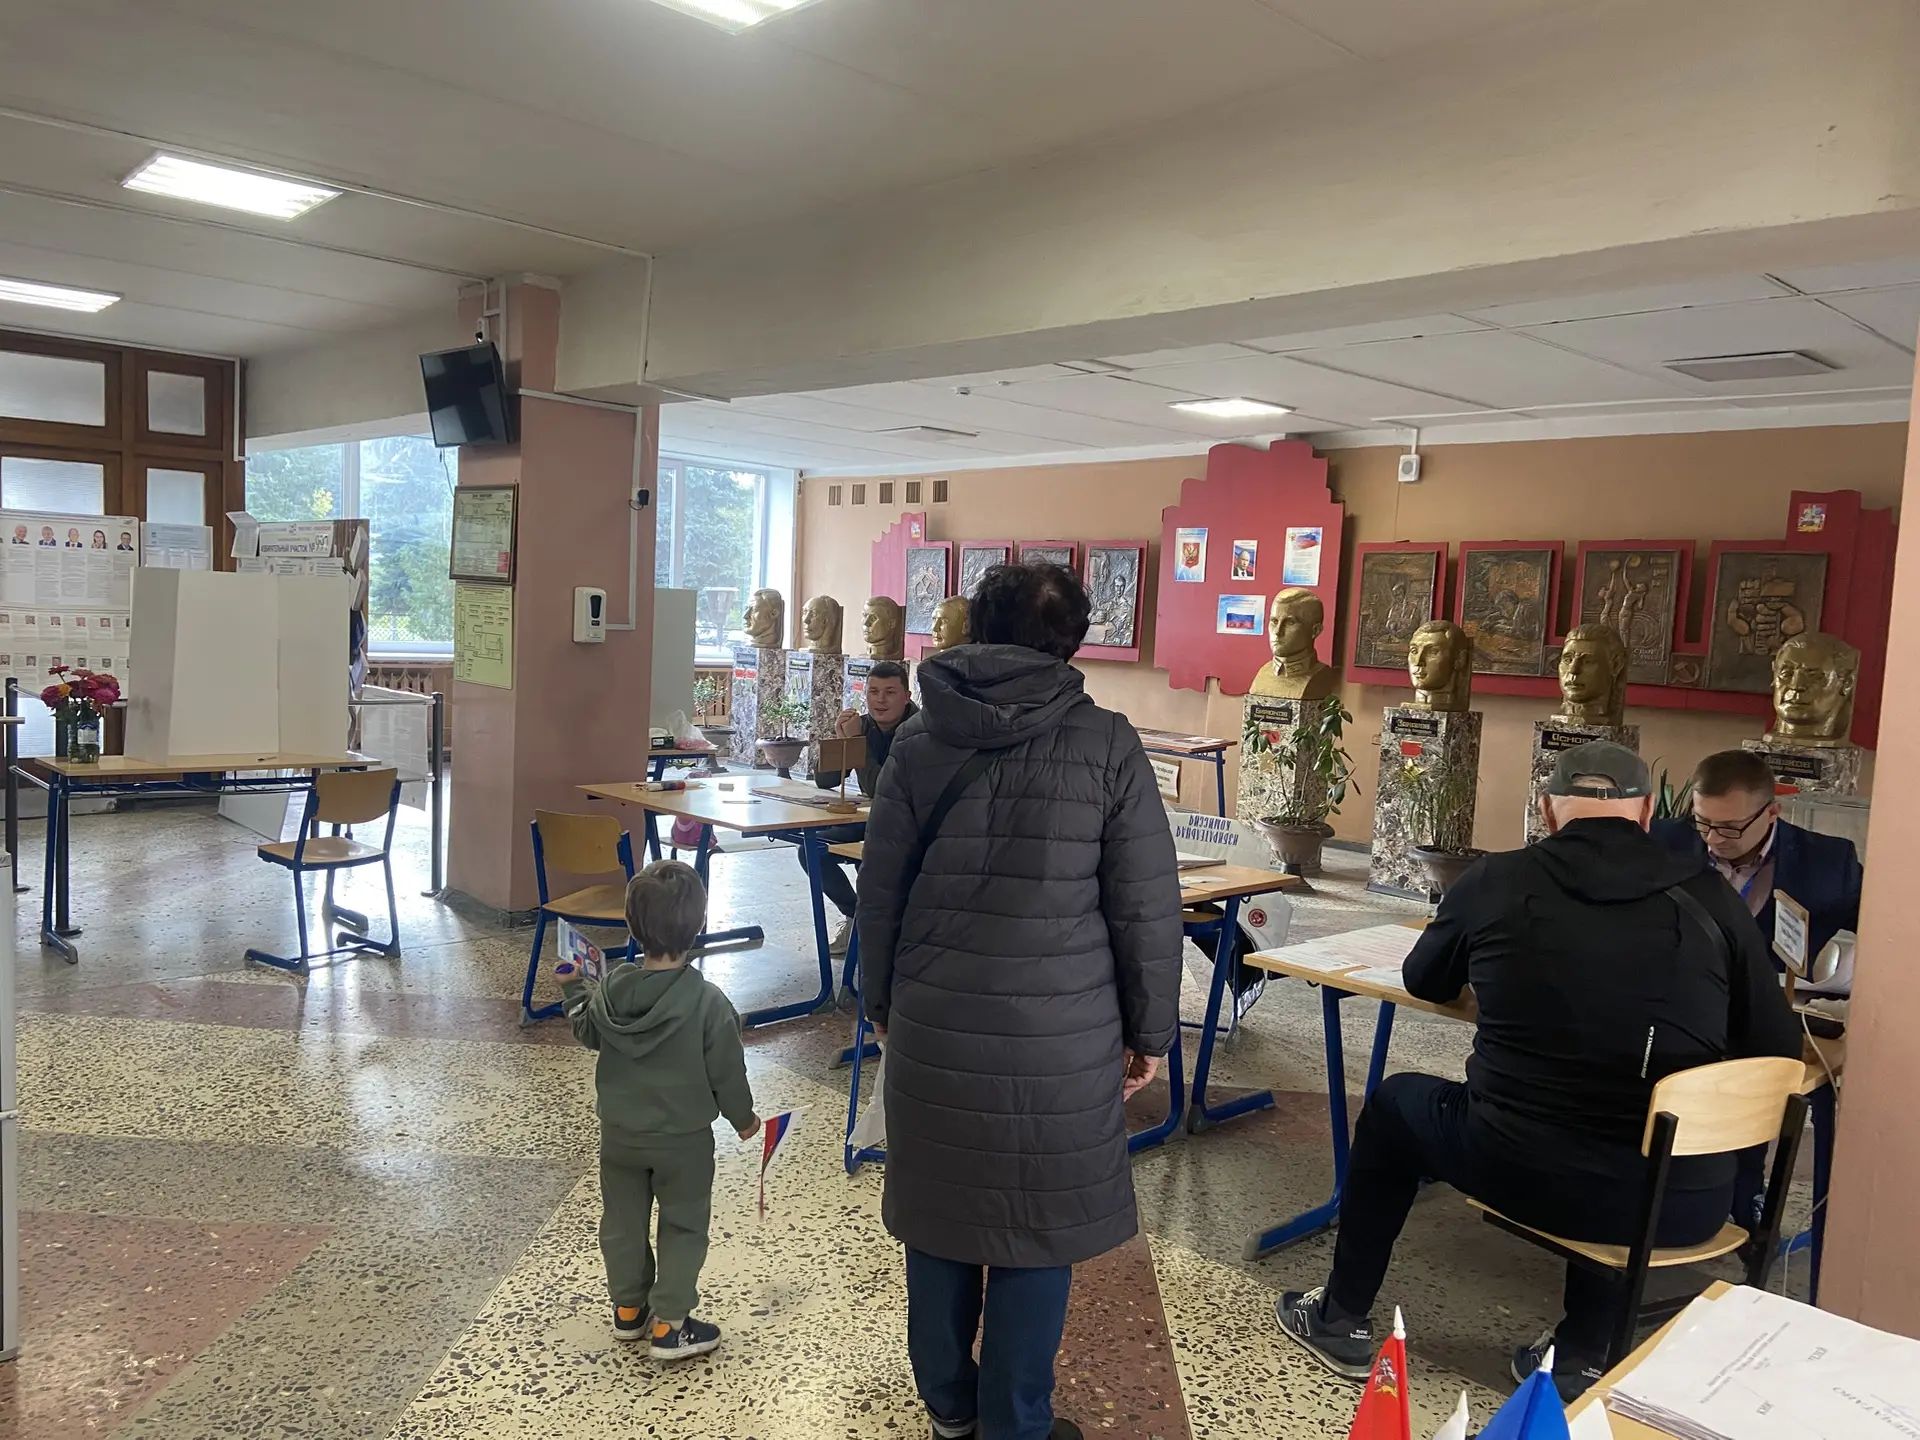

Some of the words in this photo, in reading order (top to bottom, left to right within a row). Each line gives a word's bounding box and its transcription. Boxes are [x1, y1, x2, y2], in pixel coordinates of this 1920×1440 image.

[1189, 815, 1232, 831] КОМИССИЯ
[1176, 826, 1239, 846] ИЗБИРАТЕЛЬНАЯ
[1293, 1309, 1311, 1337] N
